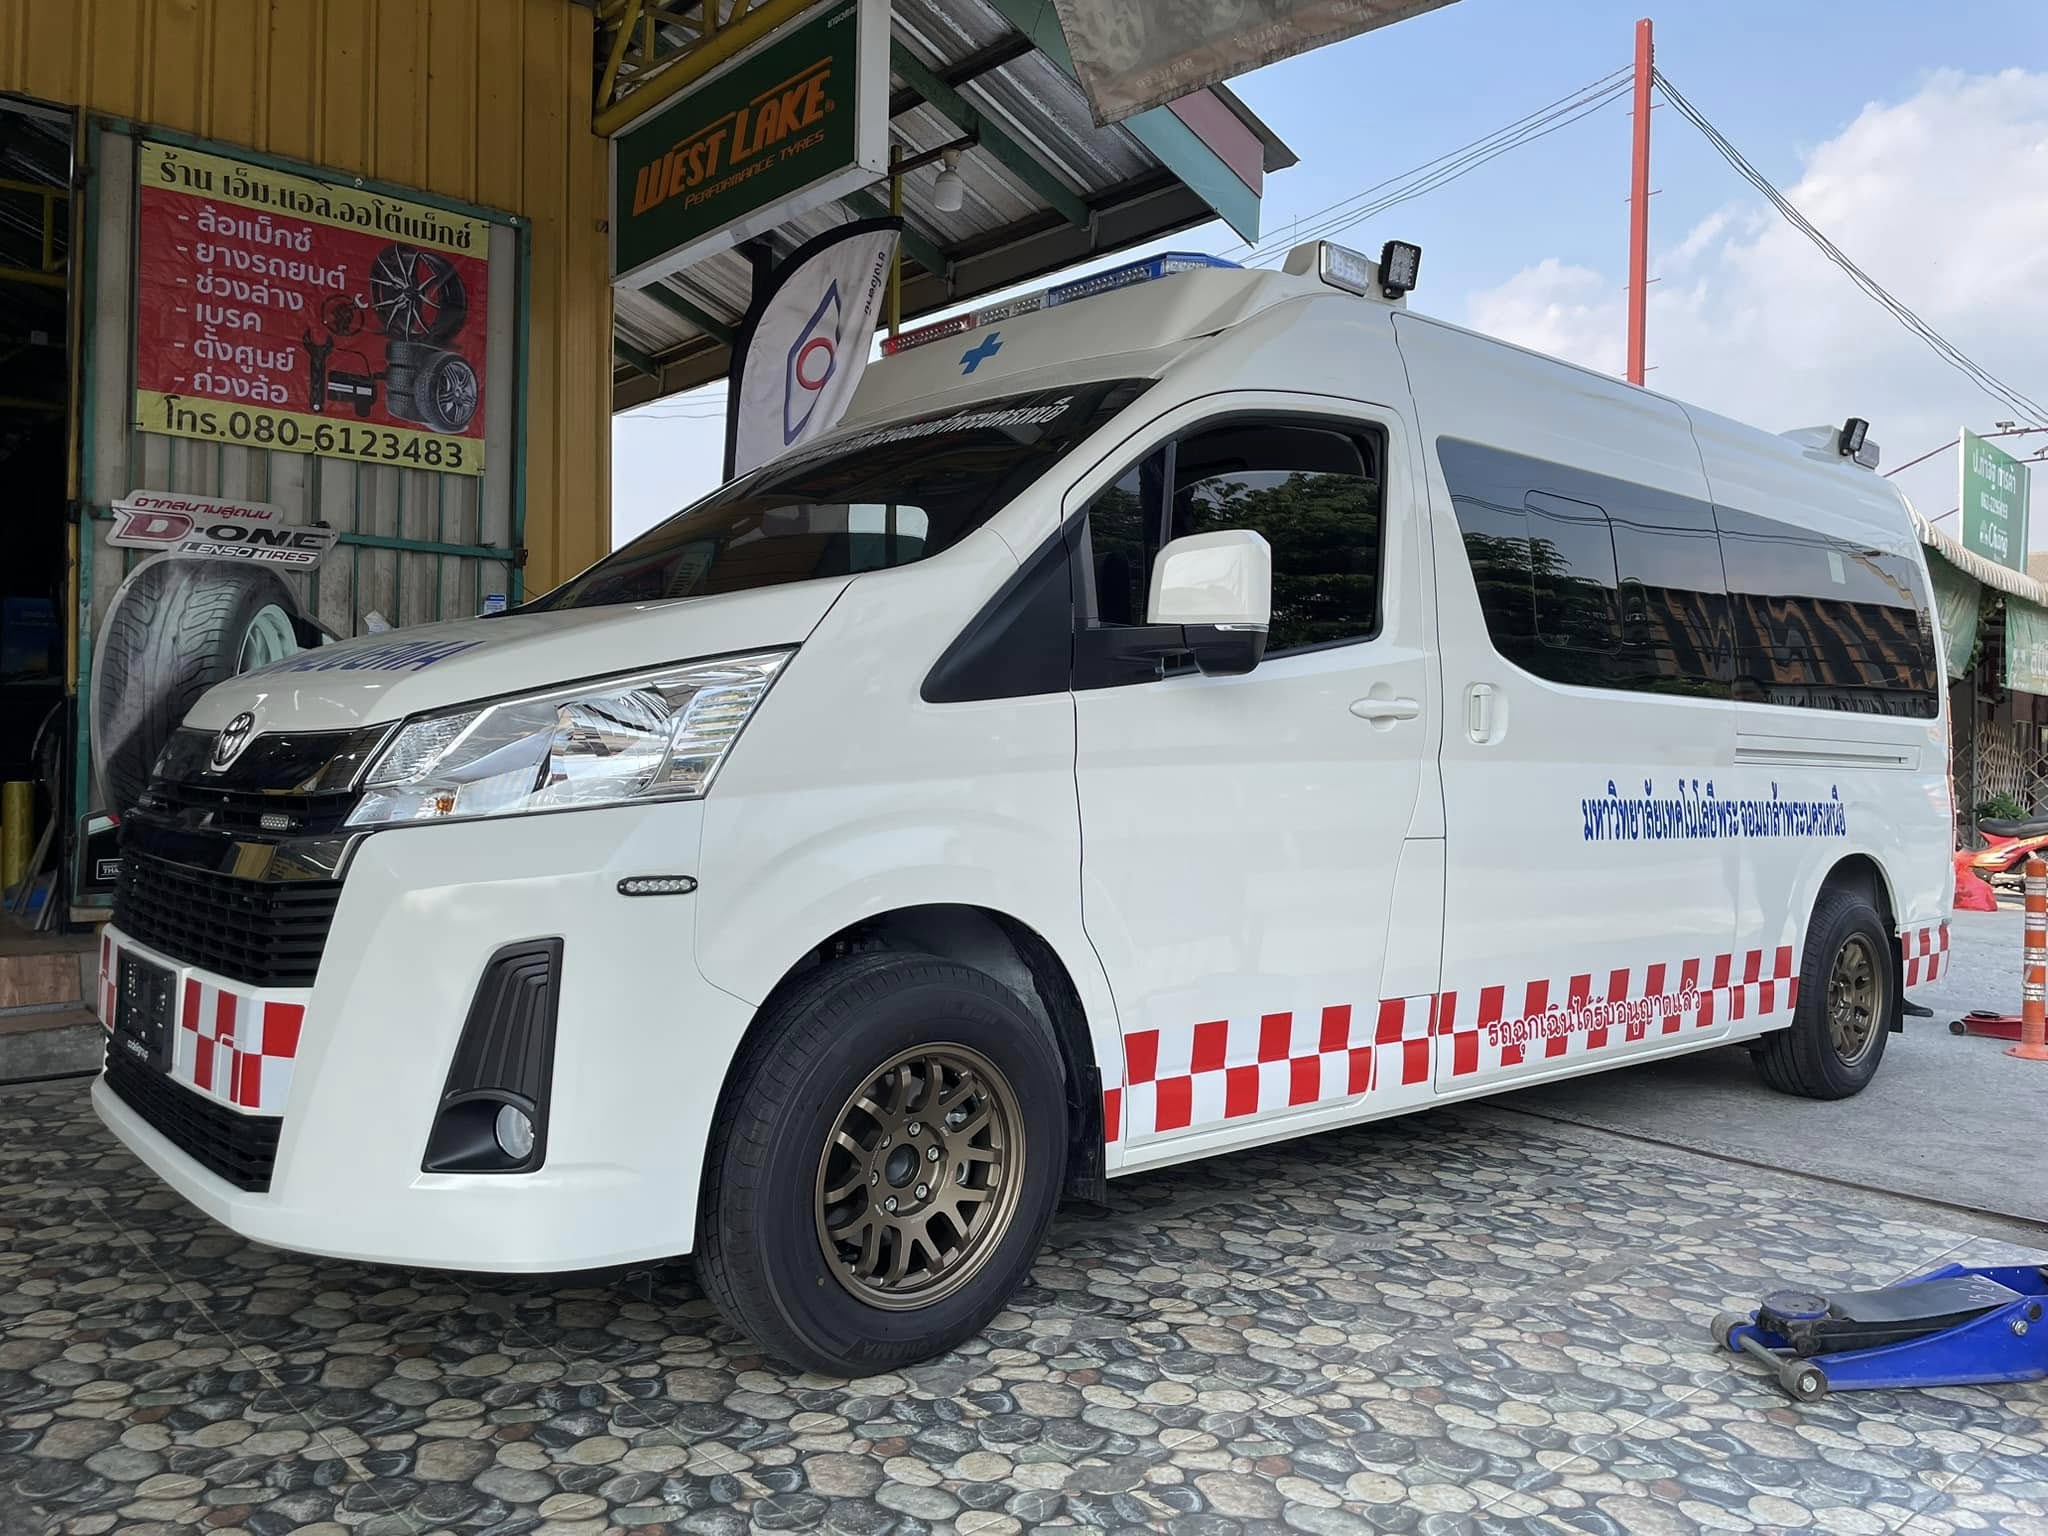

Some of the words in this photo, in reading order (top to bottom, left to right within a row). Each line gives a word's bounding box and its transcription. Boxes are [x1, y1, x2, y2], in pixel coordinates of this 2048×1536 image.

[160, 151, 213, 192] ร้าน
[684, 153, 777, 211] PERFORMANCE
[780, 128, 825, 161] TYRES
[195, 242, 348, 291] ยางรถยนต์
[195, 267, 305, 311] ช่วงล่าง
[196, 303, 263, 333] เบรค
[193, 324, 297, 375] ตั้งศูนย์
[193, 365, 289, 404] ถ่วงล้อ
[182, 541, 253, 558] LENSO
[253, 549, 311, 563] TIRES
[1488, 977, 1702, 1056] รถฉุกเฉินได้รับอนุญาตแล้ว
